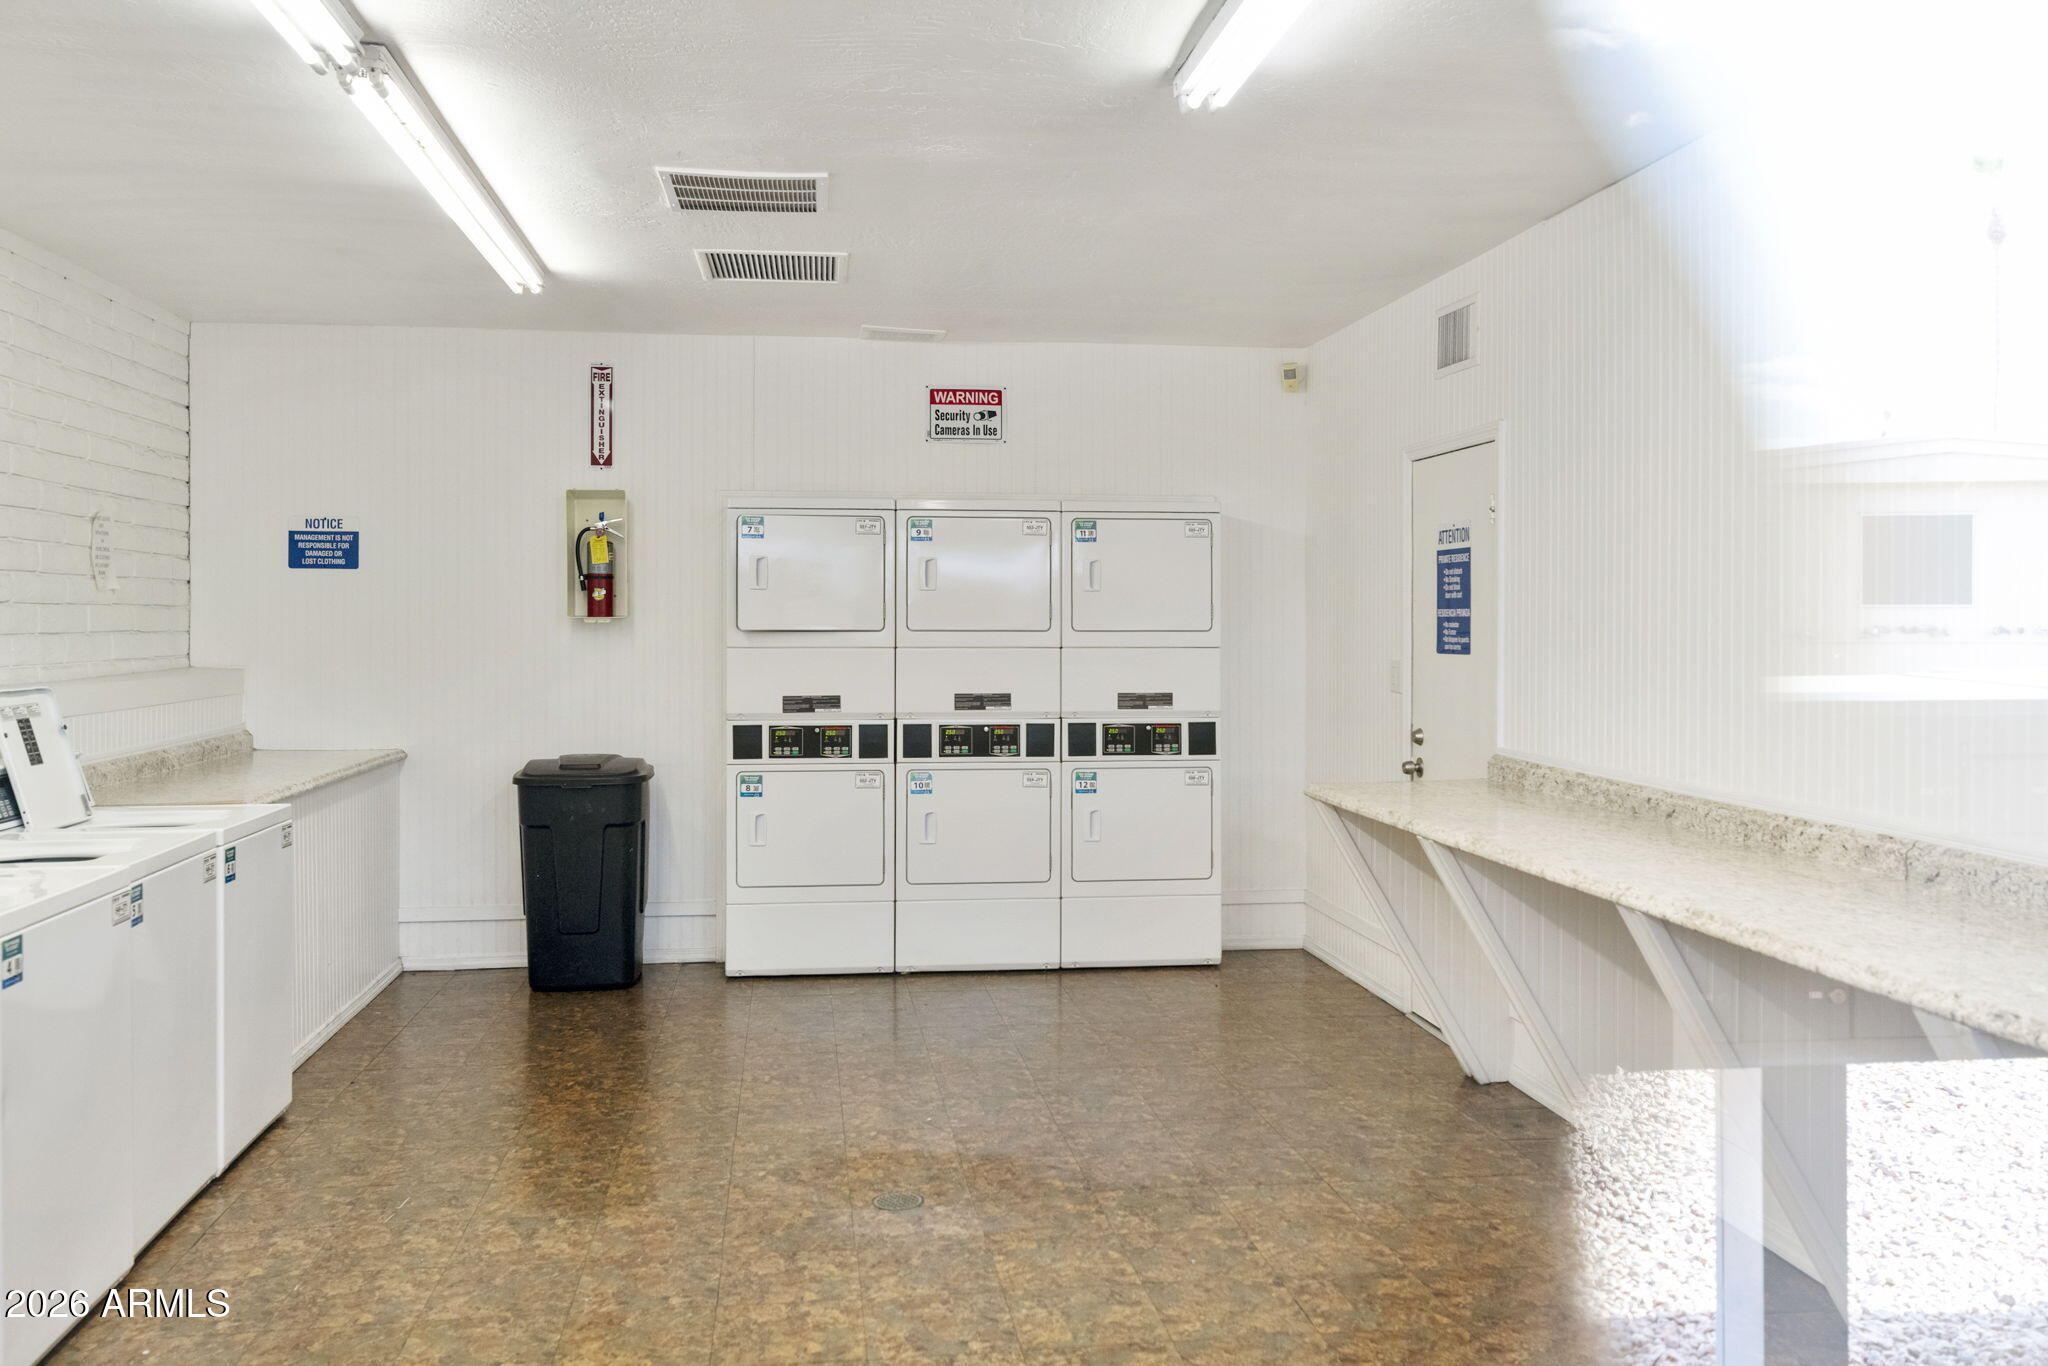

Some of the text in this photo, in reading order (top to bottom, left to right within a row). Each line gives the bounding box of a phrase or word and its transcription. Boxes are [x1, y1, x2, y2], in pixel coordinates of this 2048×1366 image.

[593, 372, 611, 381] FIRE
[934, 391, 999, 404] WARNING
[934, 409, 971, 423] Security
[934, 424, 998, 436] Cameras In Use
[305, 518, 343, 529] NOTICE
[1438, 526, 1470, 545] ATTENTION
